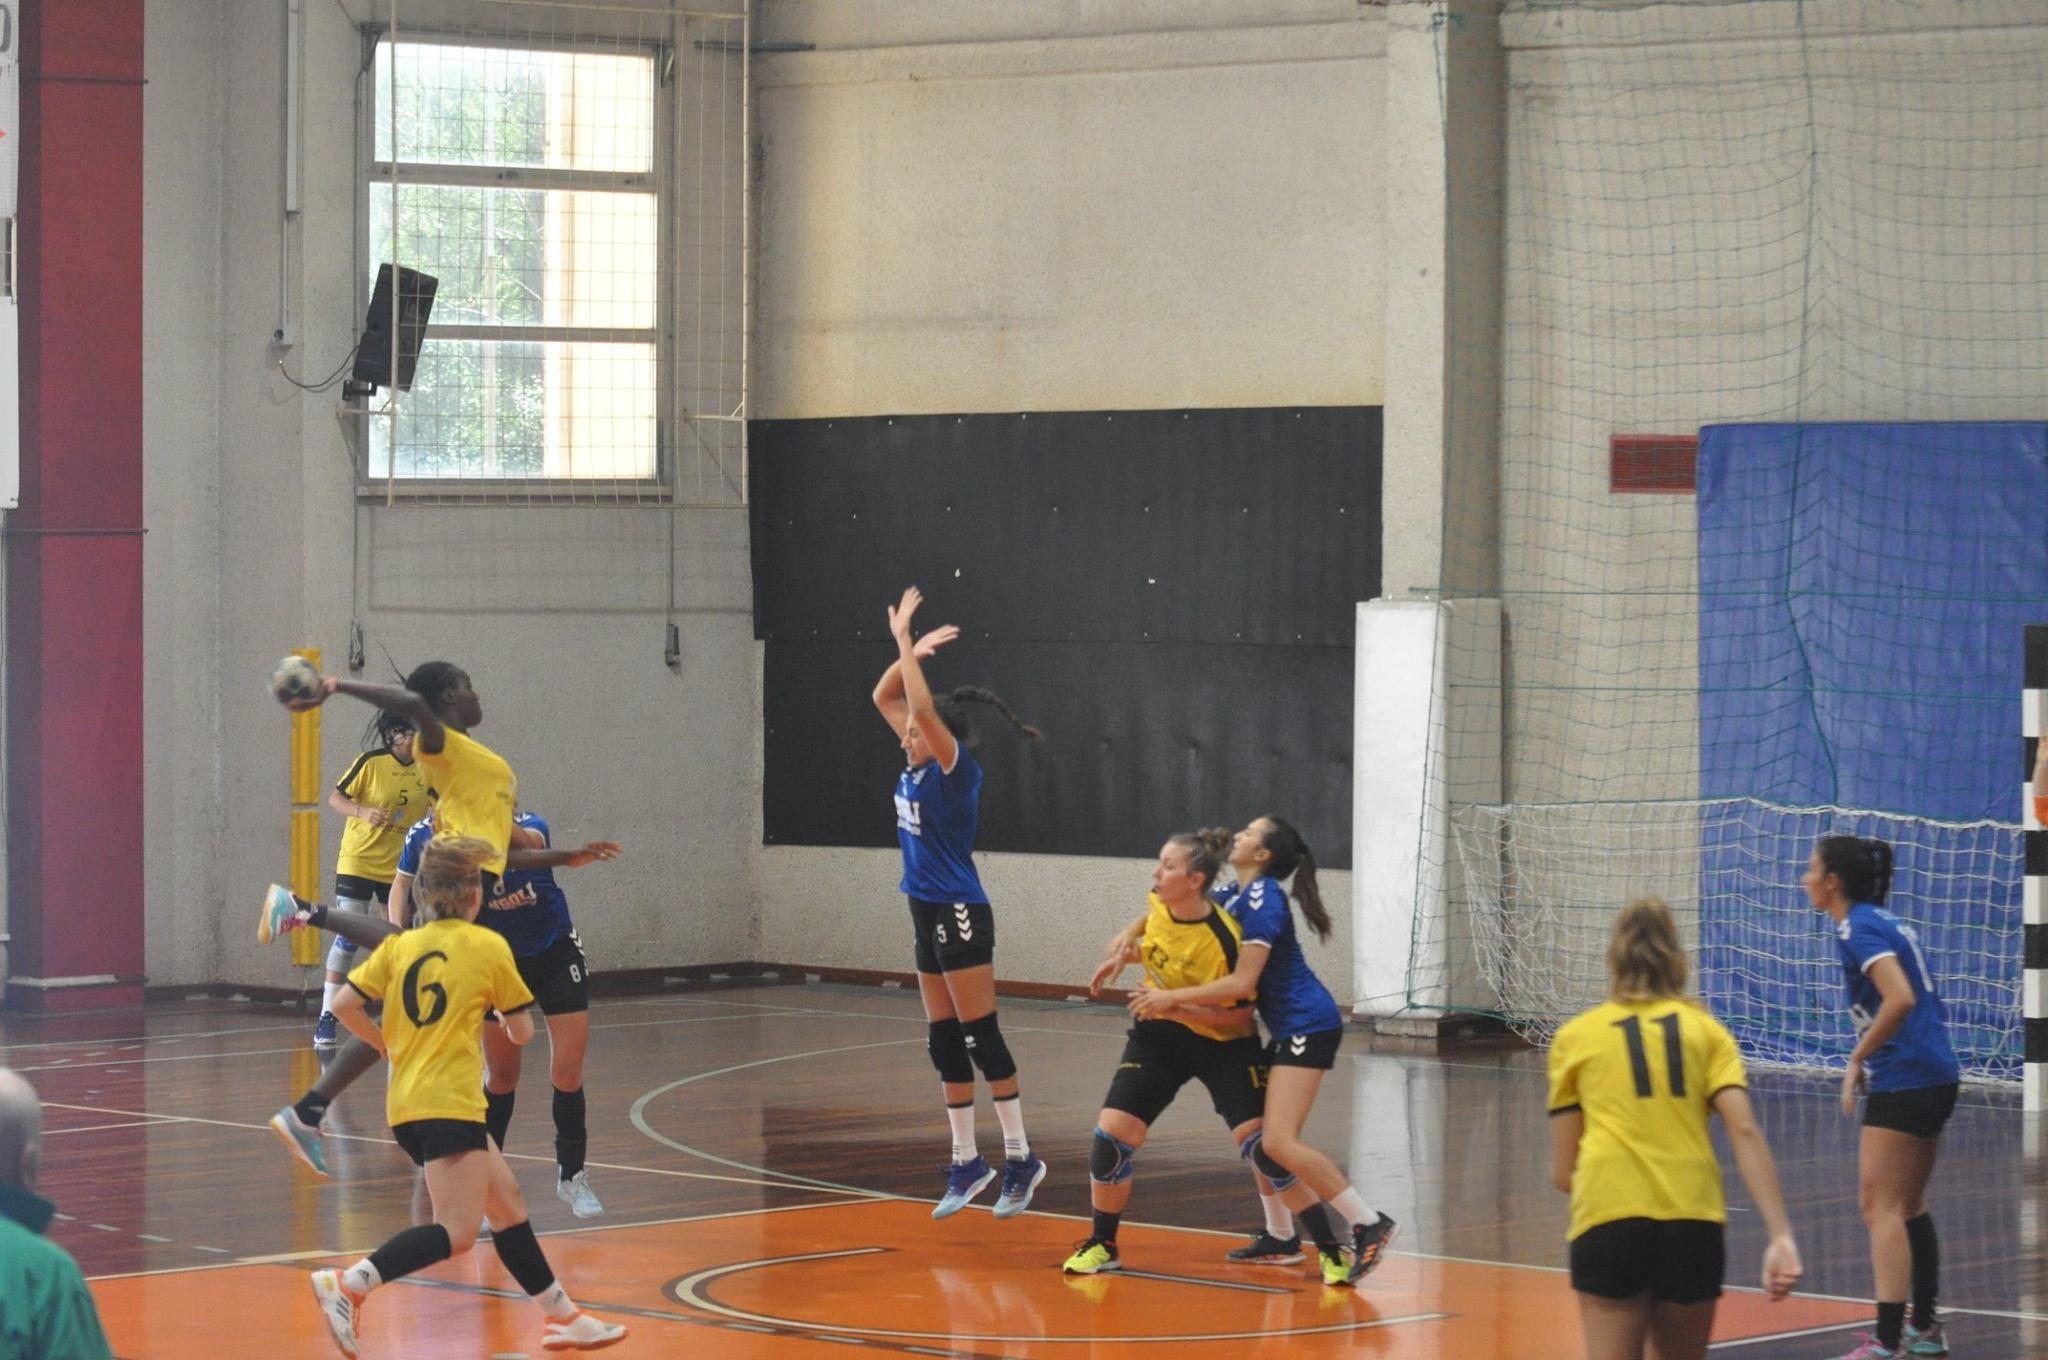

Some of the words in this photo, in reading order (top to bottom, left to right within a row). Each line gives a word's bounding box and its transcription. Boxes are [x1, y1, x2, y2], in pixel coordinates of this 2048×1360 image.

[396, 789, 409, 806] 5
[936, 924, 947, 944] 5
[1148, 943, 1169, 970] 13
[569, 964, 582, 983] 8
[402, 949, 448, 1029] 6
[1609, 1012, 1687, 1098] 11
